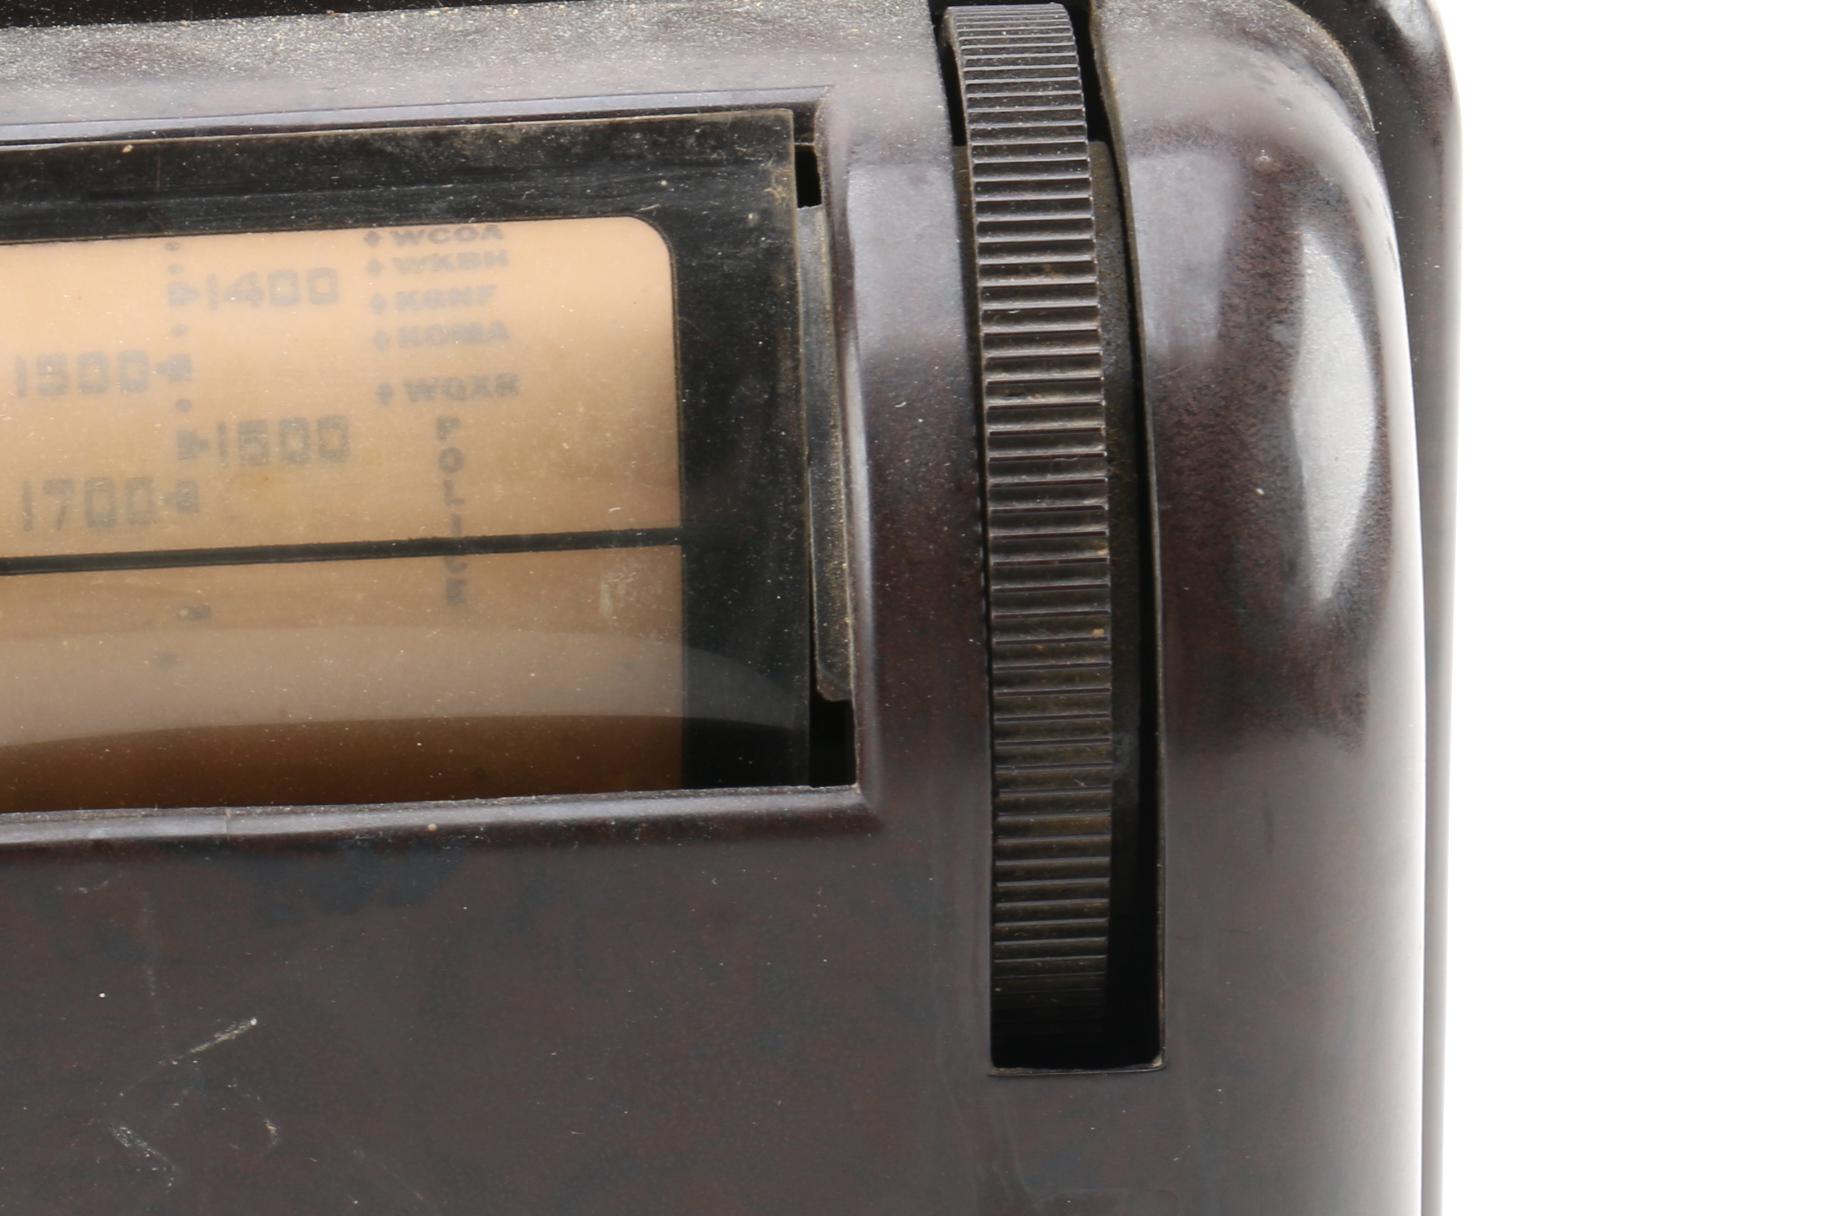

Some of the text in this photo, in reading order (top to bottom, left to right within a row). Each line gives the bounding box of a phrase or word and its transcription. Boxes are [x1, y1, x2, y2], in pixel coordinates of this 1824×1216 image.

[392, 224, 505, 246] WCOA
[393, 250, 510, 276] WKBH
[207, 267, 340, 311] 1400
[20, 476, 157, 532] 1700
